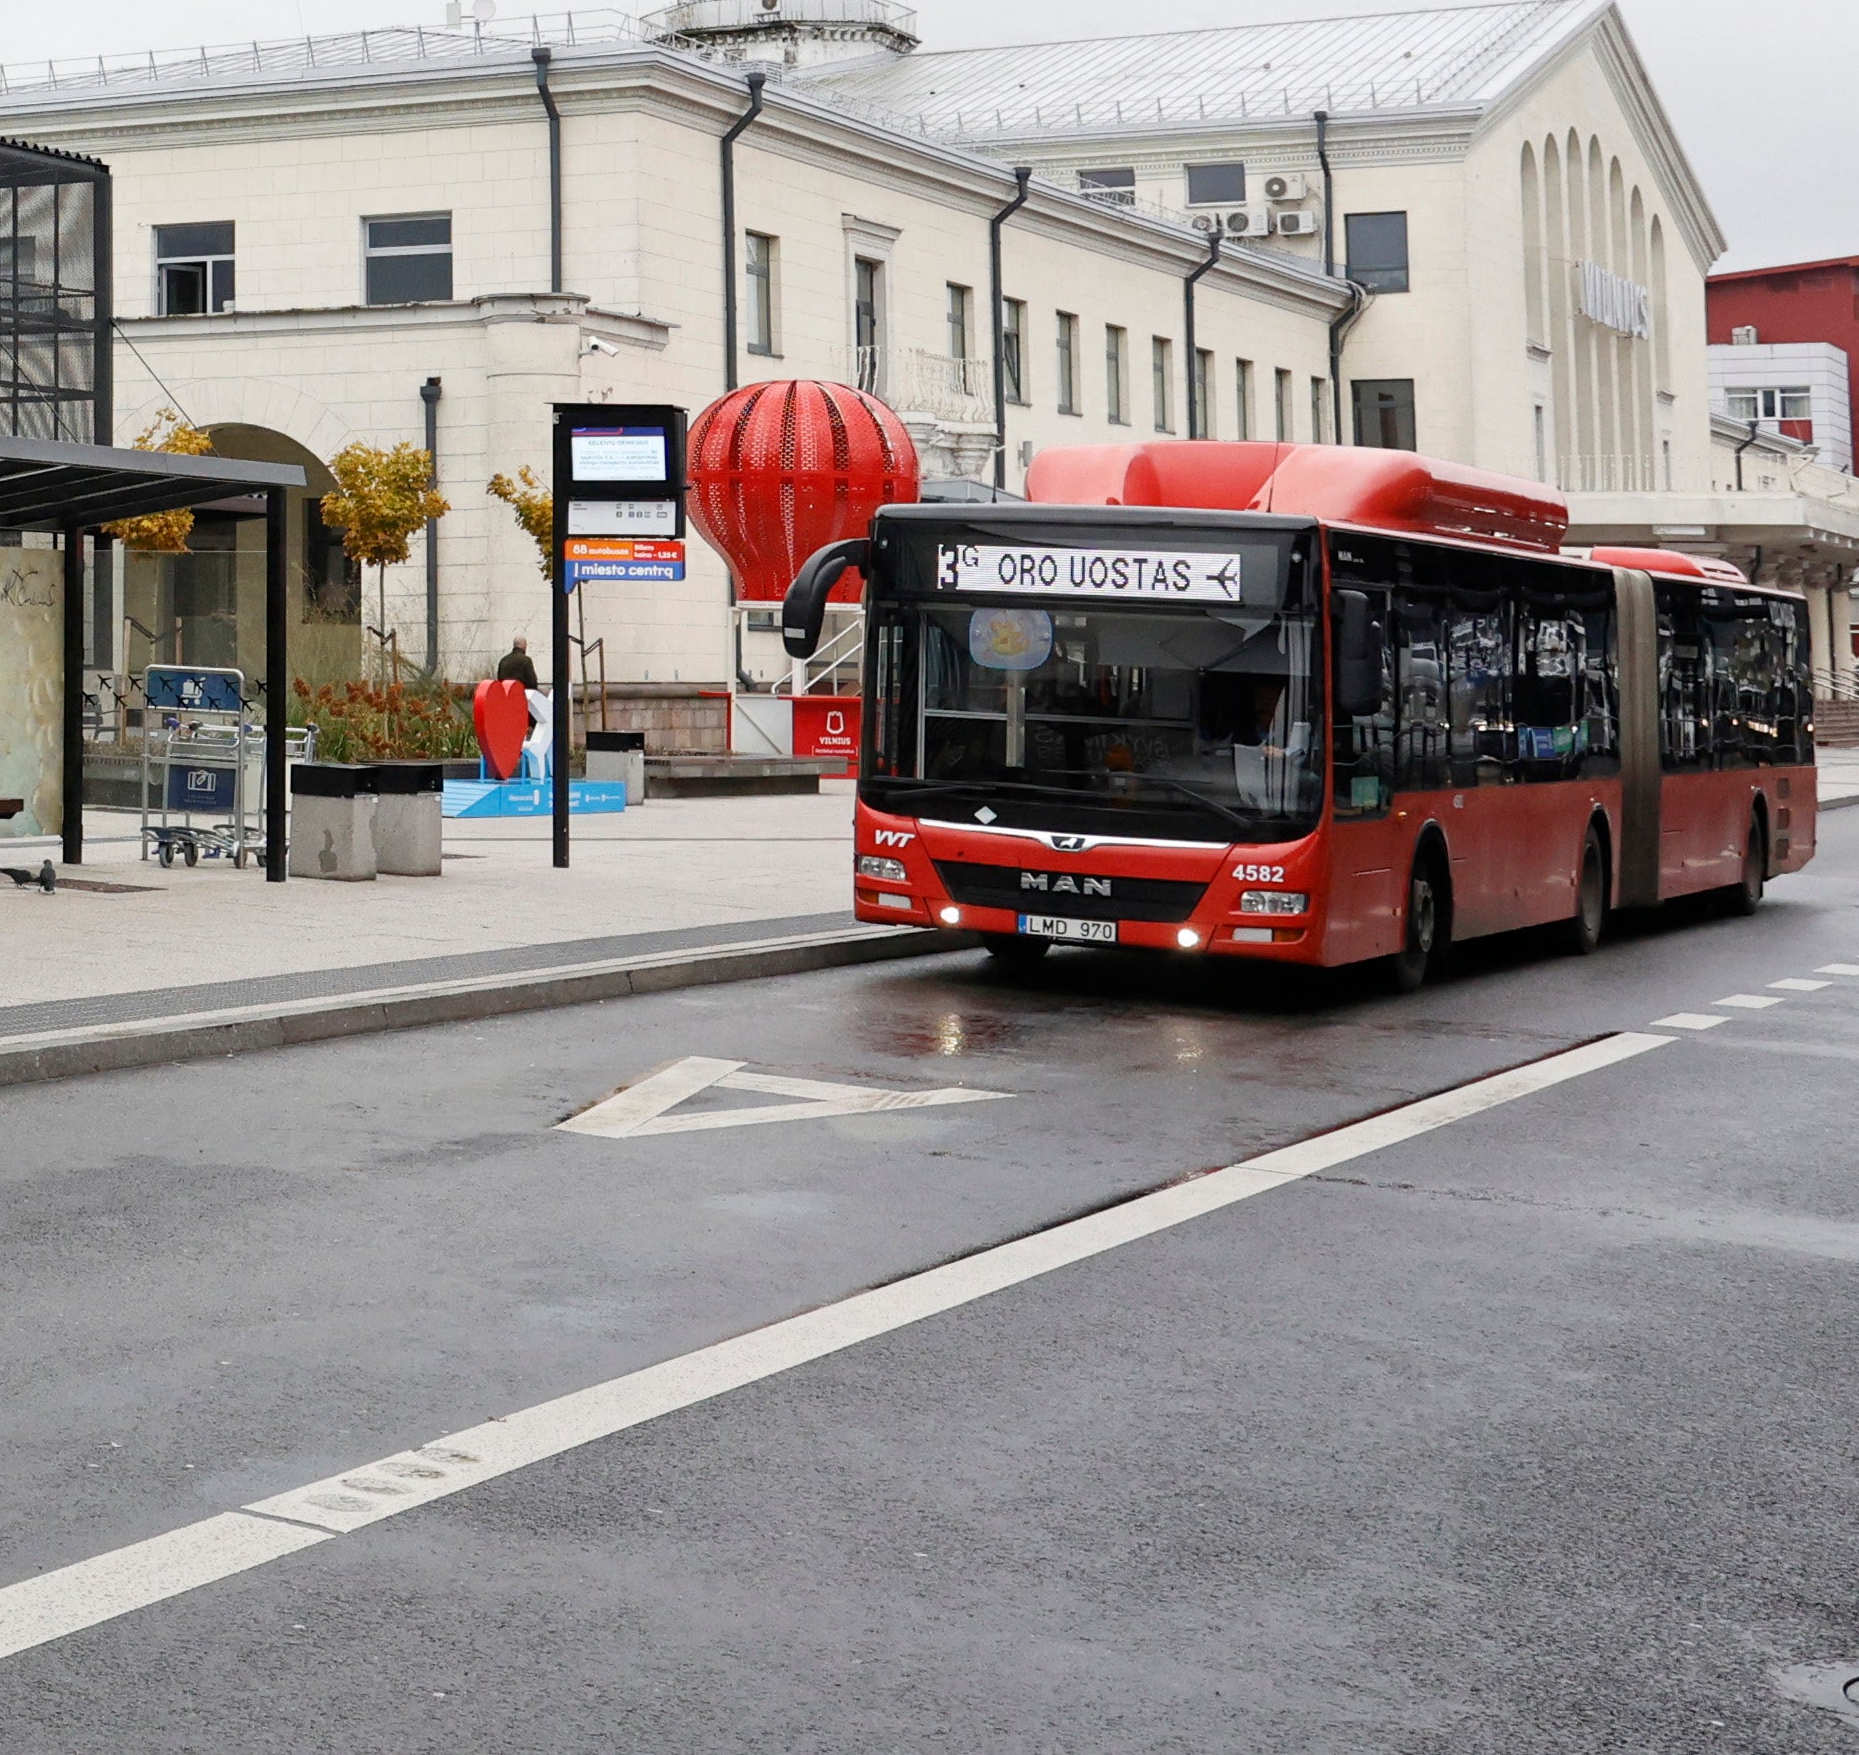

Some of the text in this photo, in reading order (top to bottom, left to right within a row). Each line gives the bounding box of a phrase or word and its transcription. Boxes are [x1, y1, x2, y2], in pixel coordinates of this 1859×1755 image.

[1579, 260, 1650, 340] VILNIUS
[573, 544, 629, 555] 88 autobusas
[581, 563, 625, 575] miesto
[628, 565, 673, 579] centrą
[999, 554, 1057, 586] ORO
[1071, 555, 1191, 591] UOSTAS
[819, 736, 851, 745] VILNIUS
[875, 830, 916, 848] VVT
[1232, 864, 1284, 883] 4582
[1021, 872, 1112, 896] MAN
[1029, 917, 1112, 939] LMD 970
